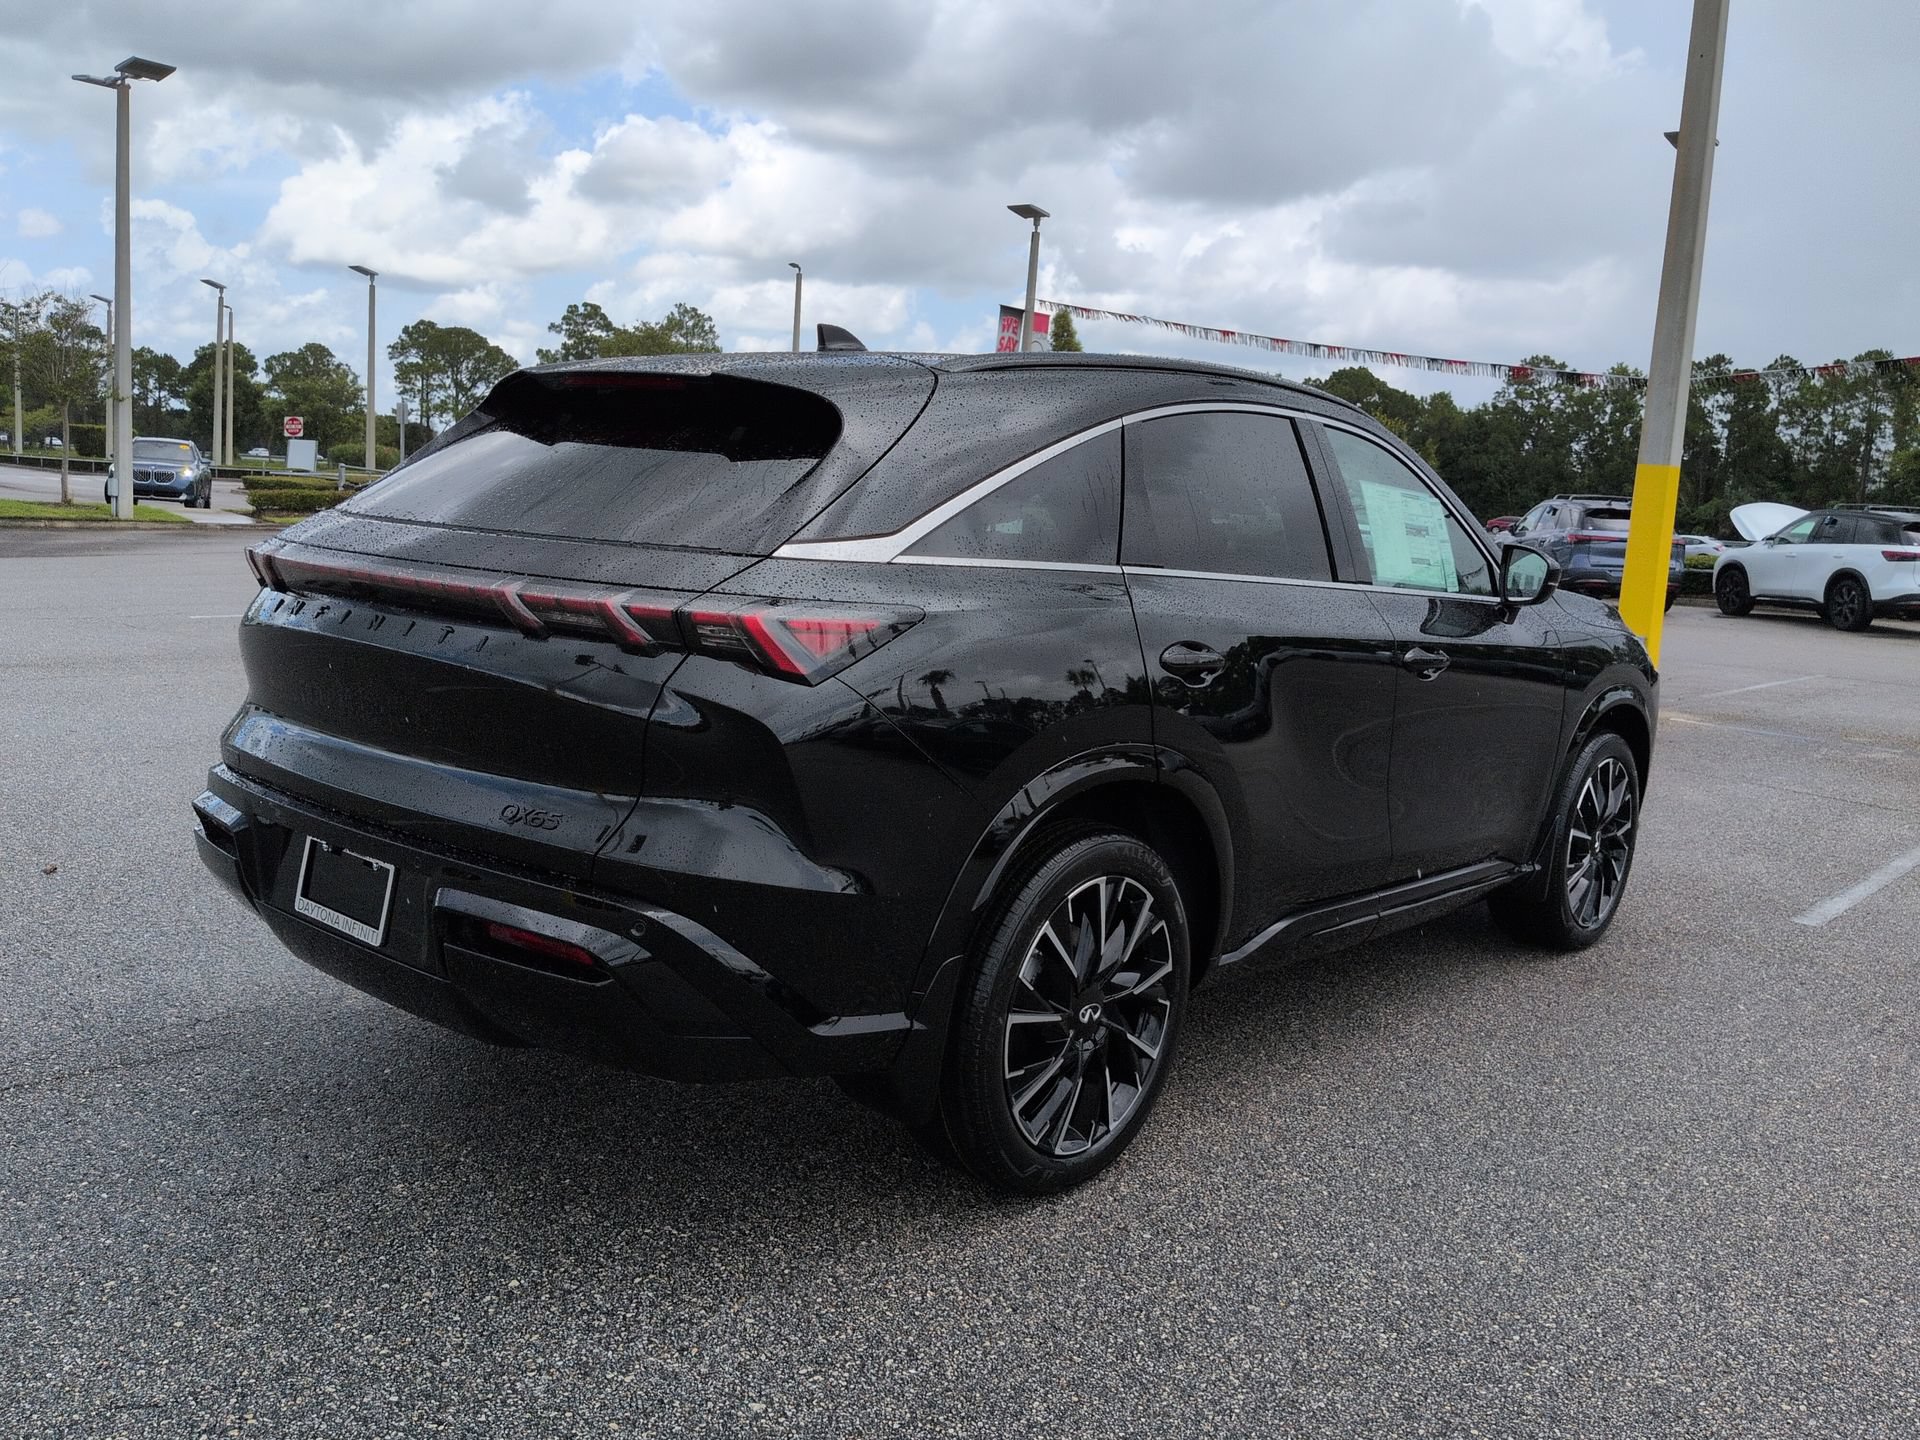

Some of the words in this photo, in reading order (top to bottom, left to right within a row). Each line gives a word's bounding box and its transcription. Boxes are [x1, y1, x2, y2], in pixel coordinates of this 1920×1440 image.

[1002, 316, 1019, 336] WE
[274, 599, 489, 652] INFINITI
[501, 804, 563, 830] QX65
[297, 899, 340, 927] DAYTONA
[341, 917, 379, 945] INFINITI
